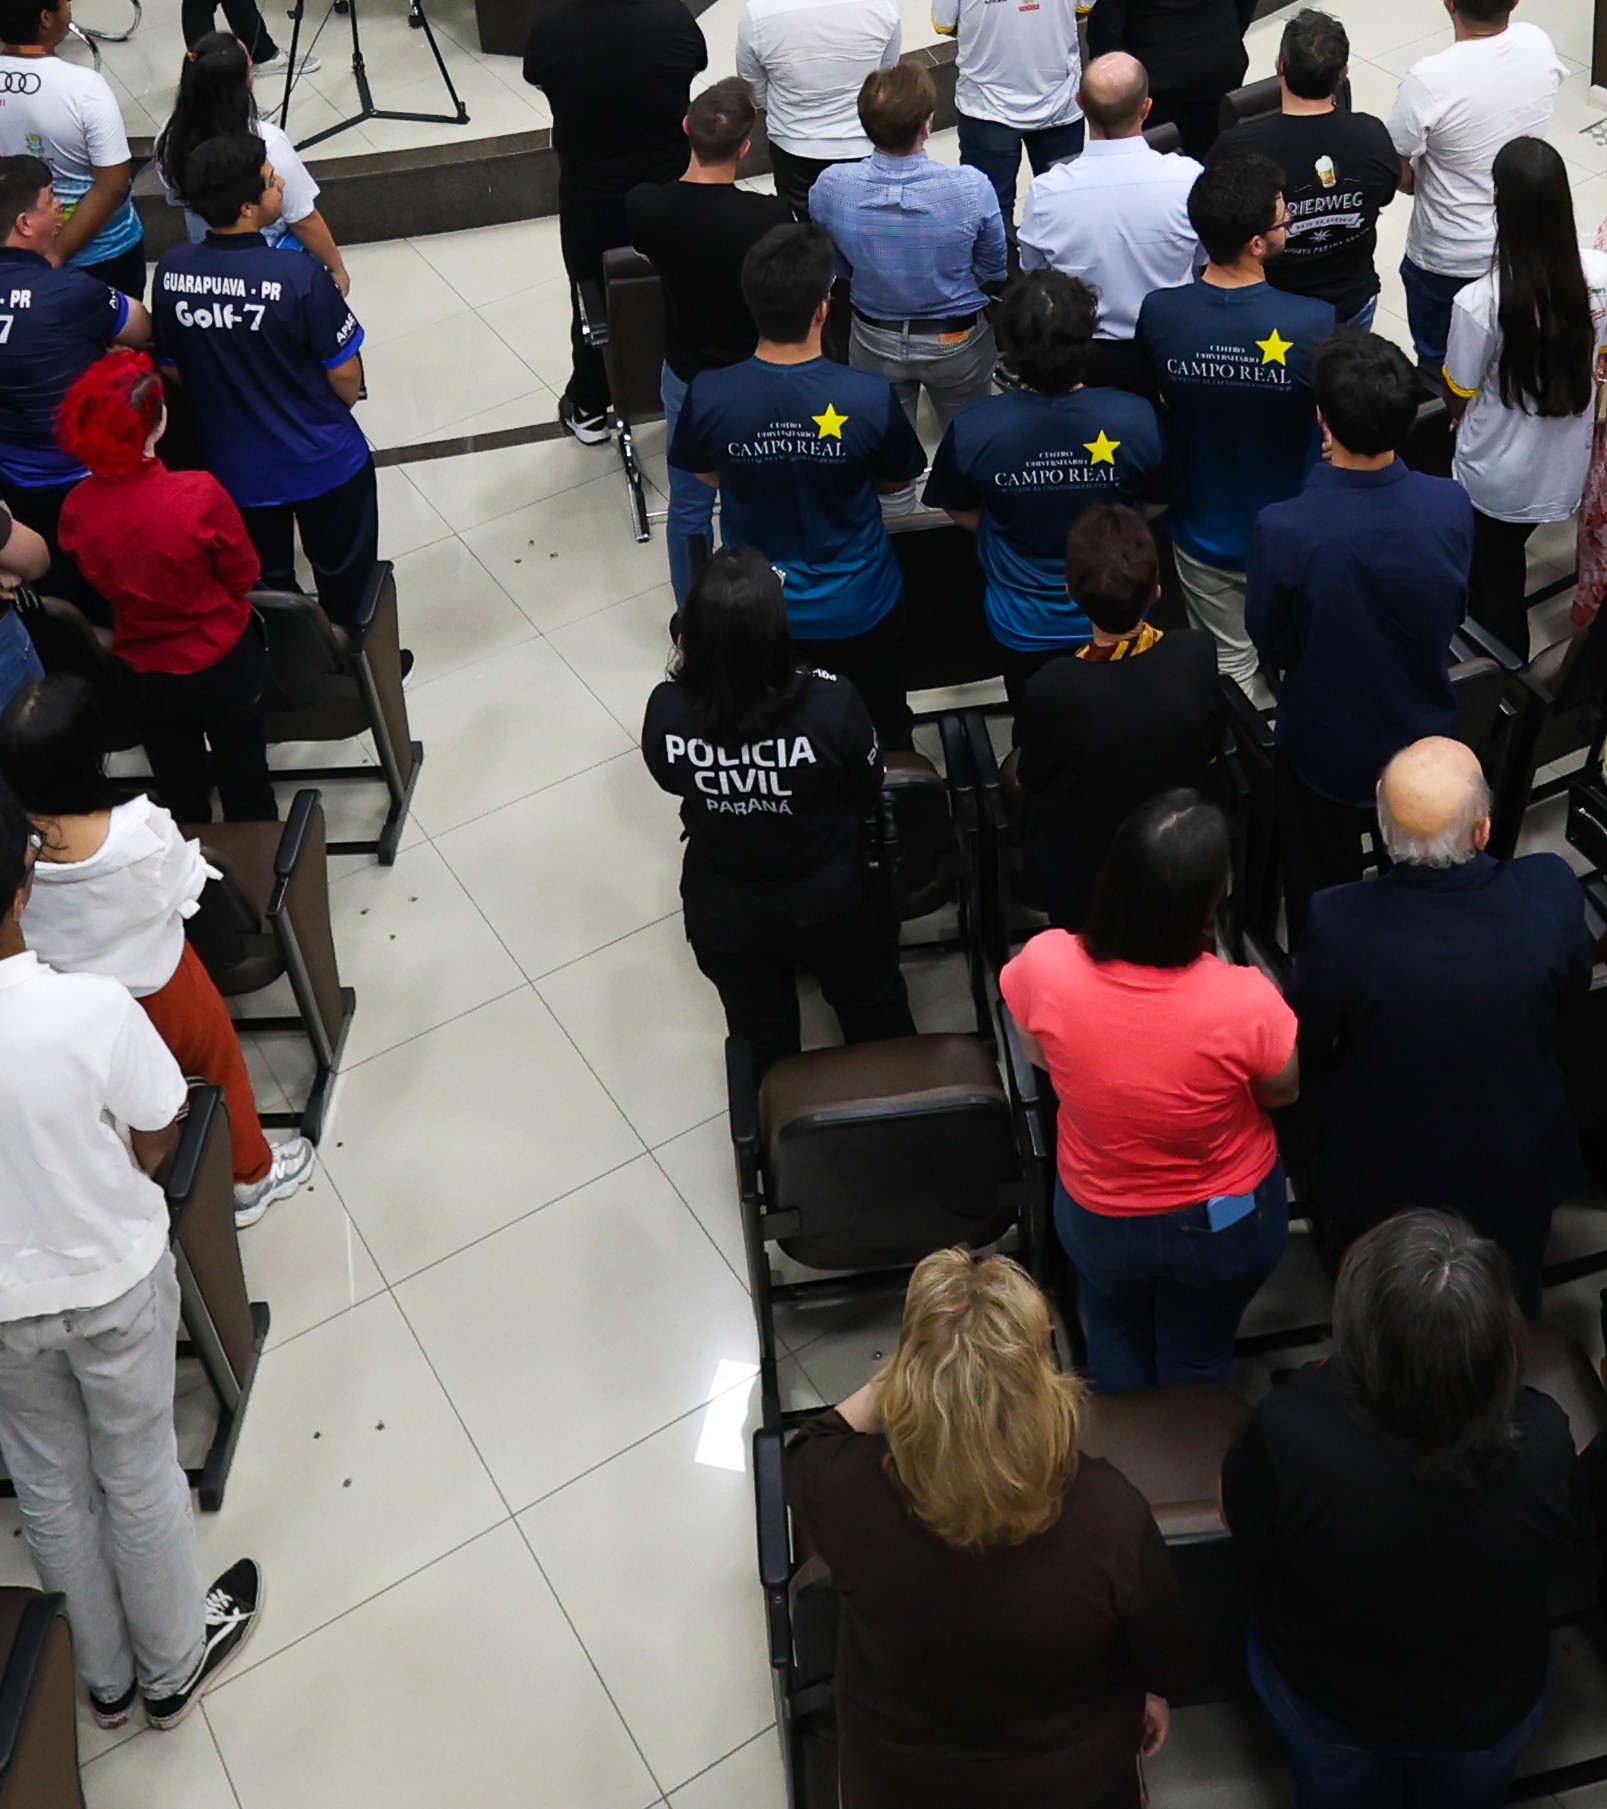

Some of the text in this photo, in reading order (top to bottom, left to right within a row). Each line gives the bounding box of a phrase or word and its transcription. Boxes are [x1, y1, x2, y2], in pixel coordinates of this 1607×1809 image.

[163, 271, 246, 297] GUARAPUAVA
[261, 281, 282, 301] PR
[9, 289, 32, 309] PR
[175, 300, 266, 332] Golf-7
[1167, 358, 1235, 379] CAMPO
[1239, 365, 1291, 384] REAL
[727, 438, 847, 457] CAMPO REAL
[994, 469, 1064, 487] CAMPO
[1069, 466, 1120, 483] REAL
[694, 768, 793, 797] CIVIL
[706, 798, 793, 816] PARANÁ
